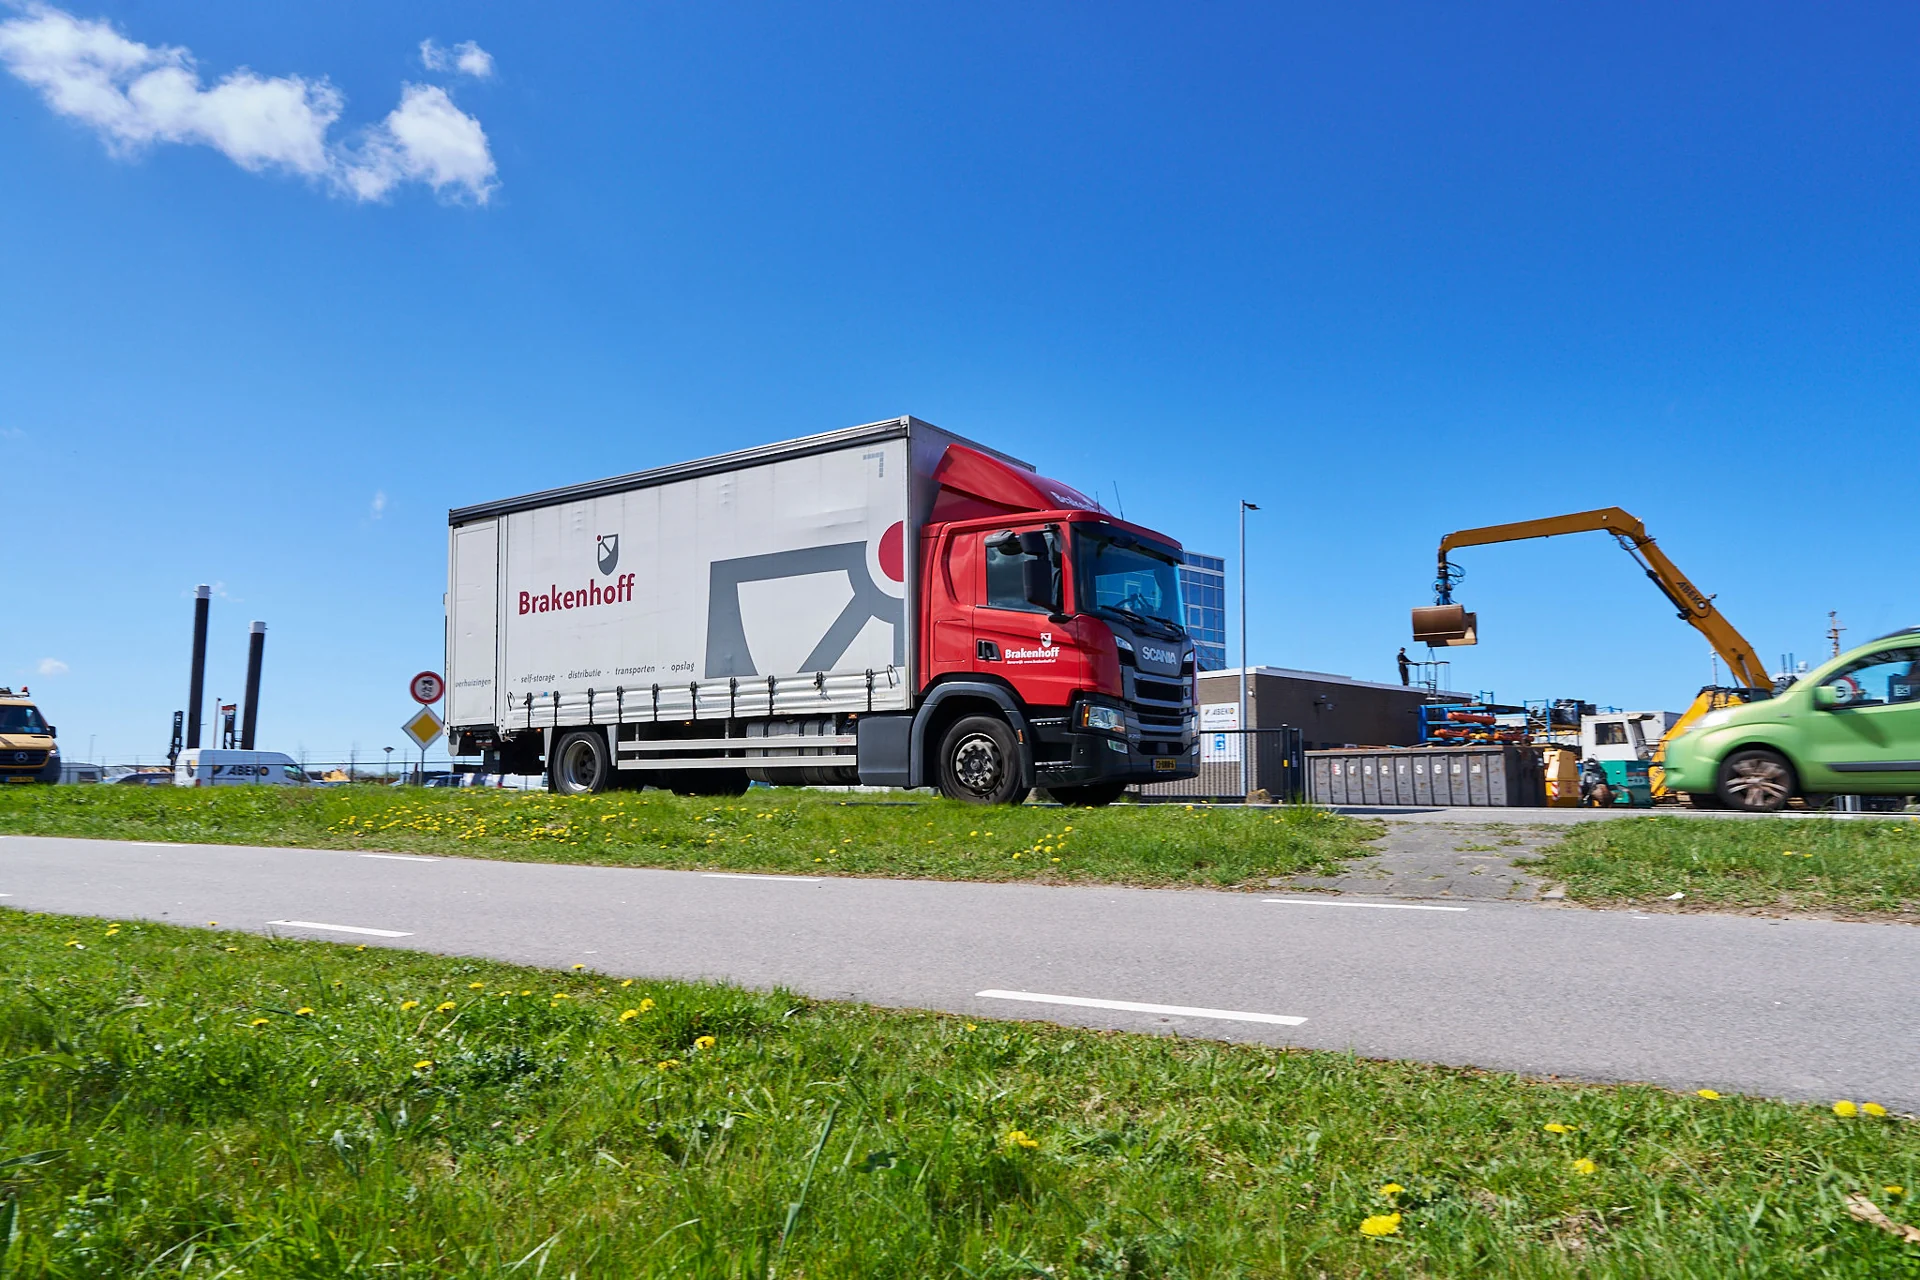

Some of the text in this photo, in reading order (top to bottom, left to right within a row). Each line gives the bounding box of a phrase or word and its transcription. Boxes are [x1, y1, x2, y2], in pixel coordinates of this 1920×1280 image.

[518, 573, 635, 615] Brakenhoff
[1005, 647, 1059, 659] Brakenhoff
[1142, 646, 1177, 665] SCANIA
[520, 673, 556, 684] self-storage
[567, 668, 602, 679] distributie
[615, 664, 656, 676] transporten
[670, 660, 695, 672] opslag
